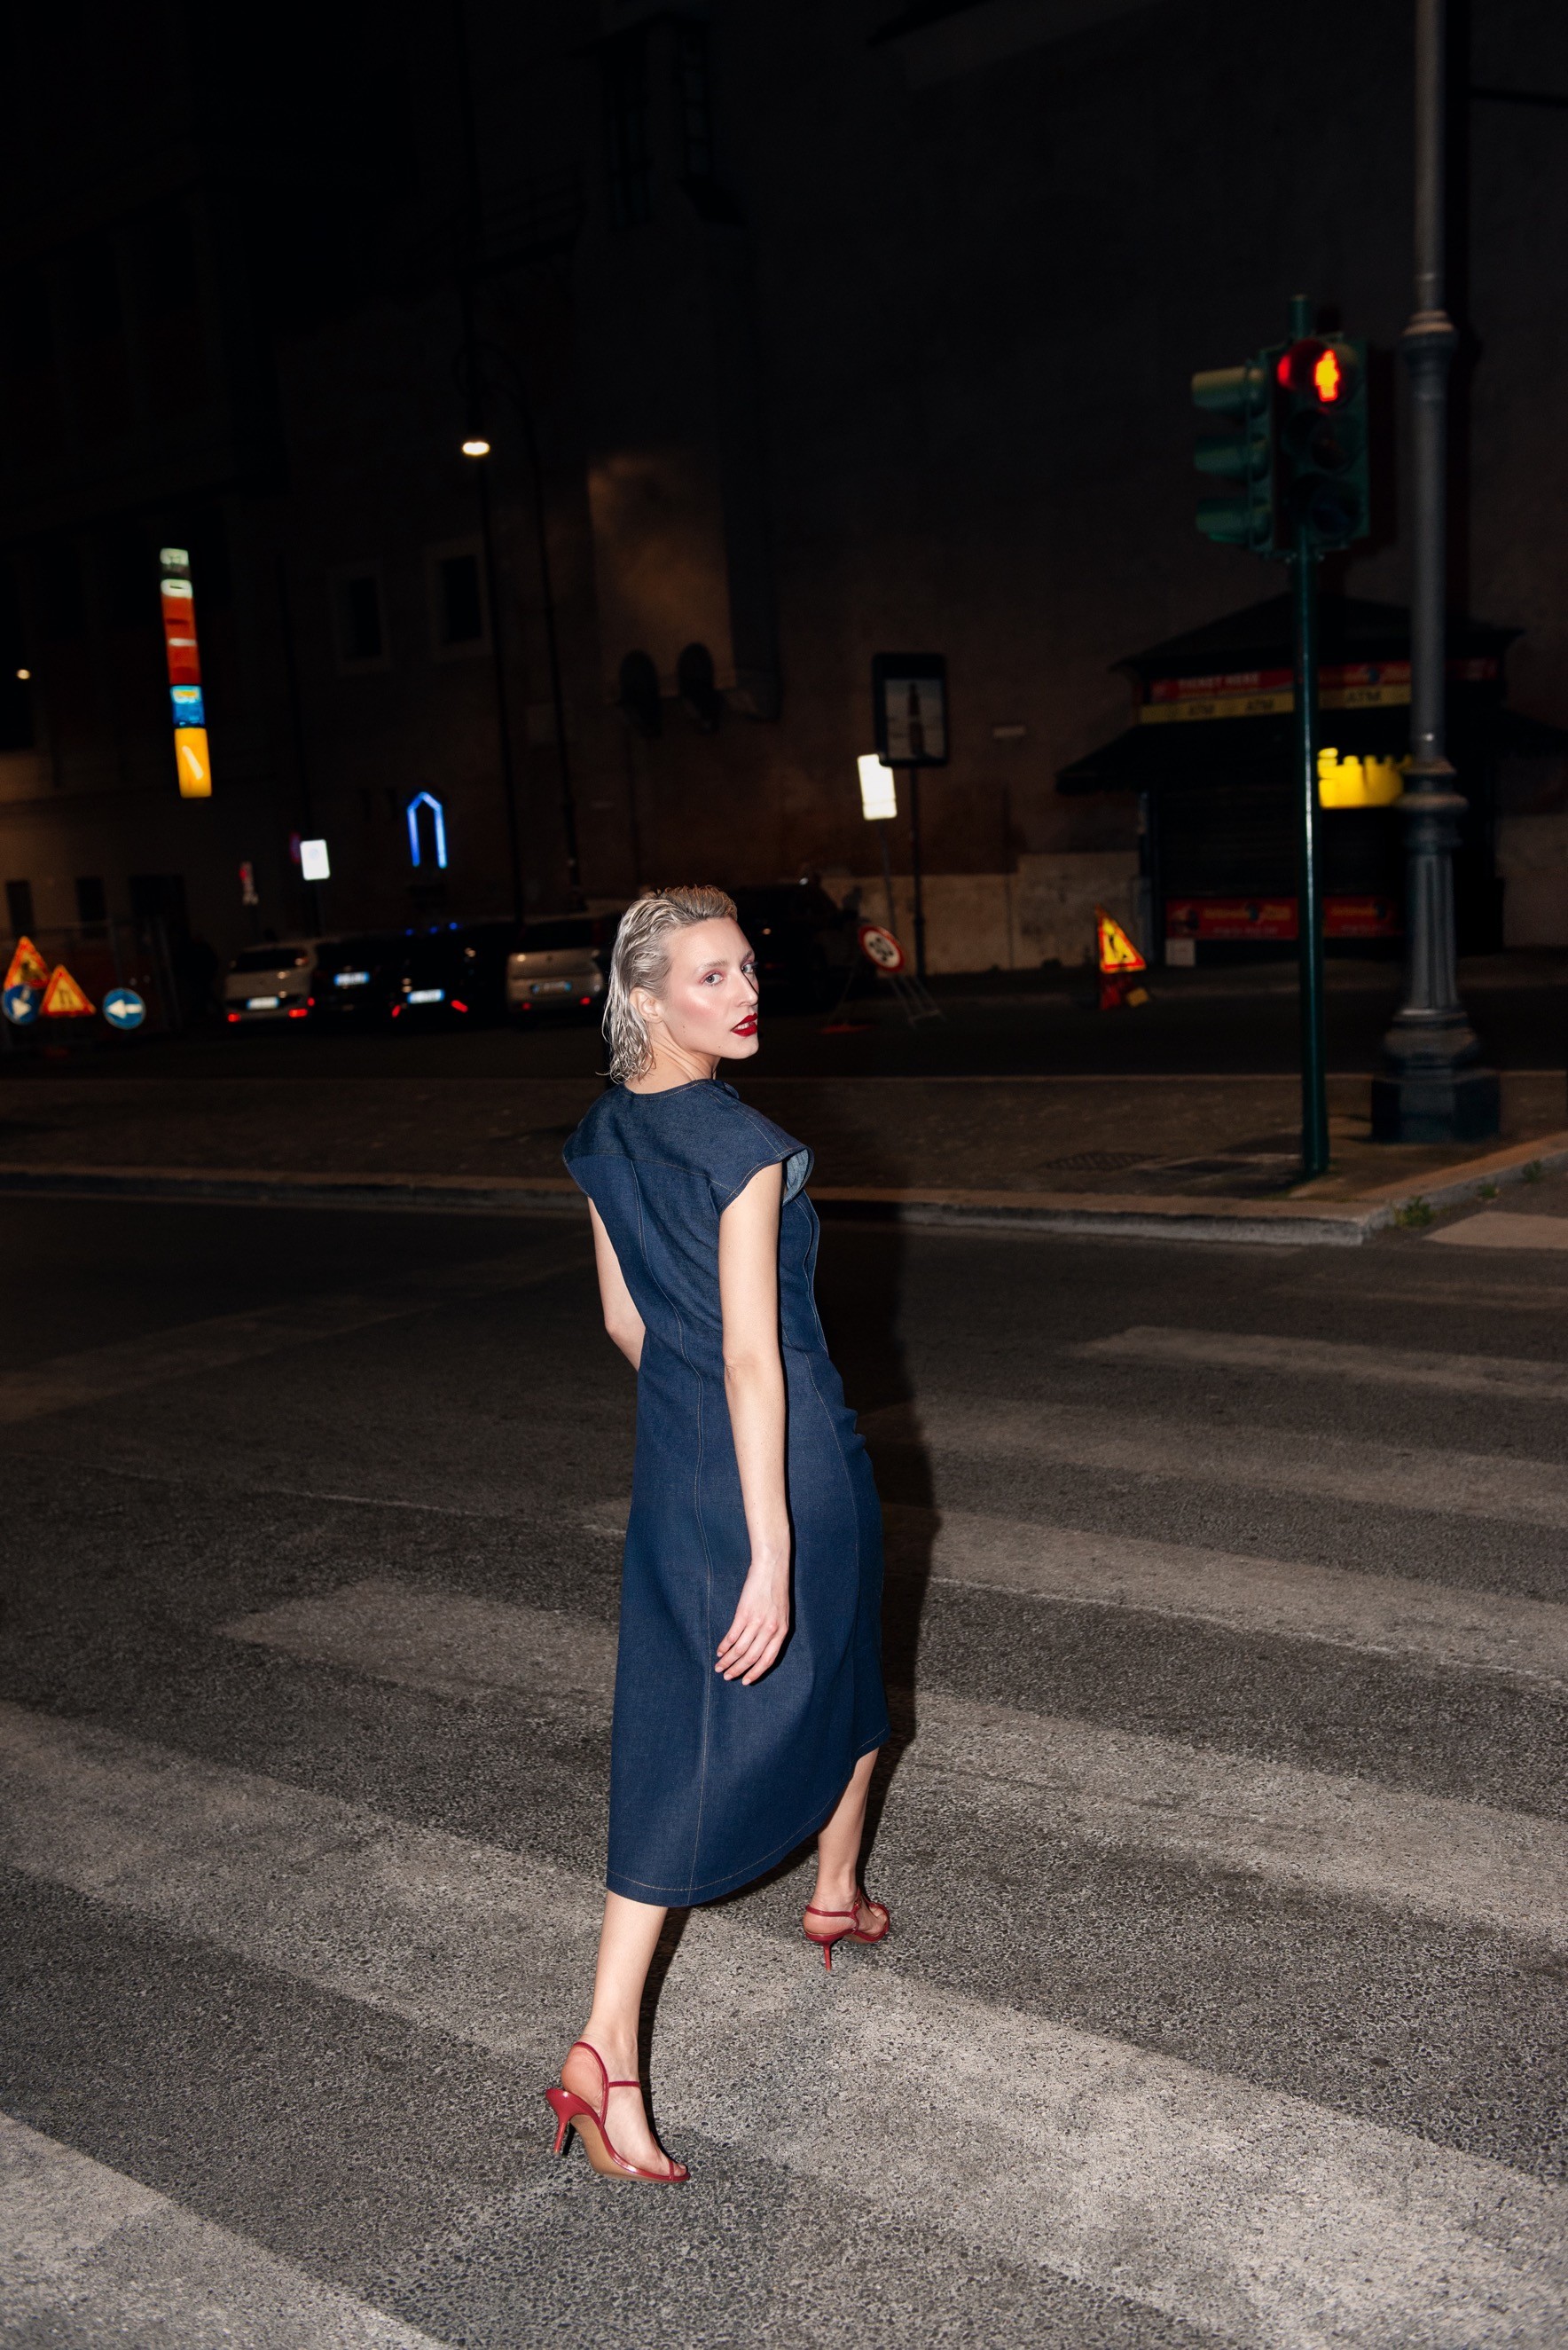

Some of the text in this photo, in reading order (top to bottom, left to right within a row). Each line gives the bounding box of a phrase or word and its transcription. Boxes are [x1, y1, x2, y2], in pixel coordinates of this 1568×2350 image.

[1346, 690, 1381, 703] ATM
[1188, 698, 1274, 717] ATM ATM
